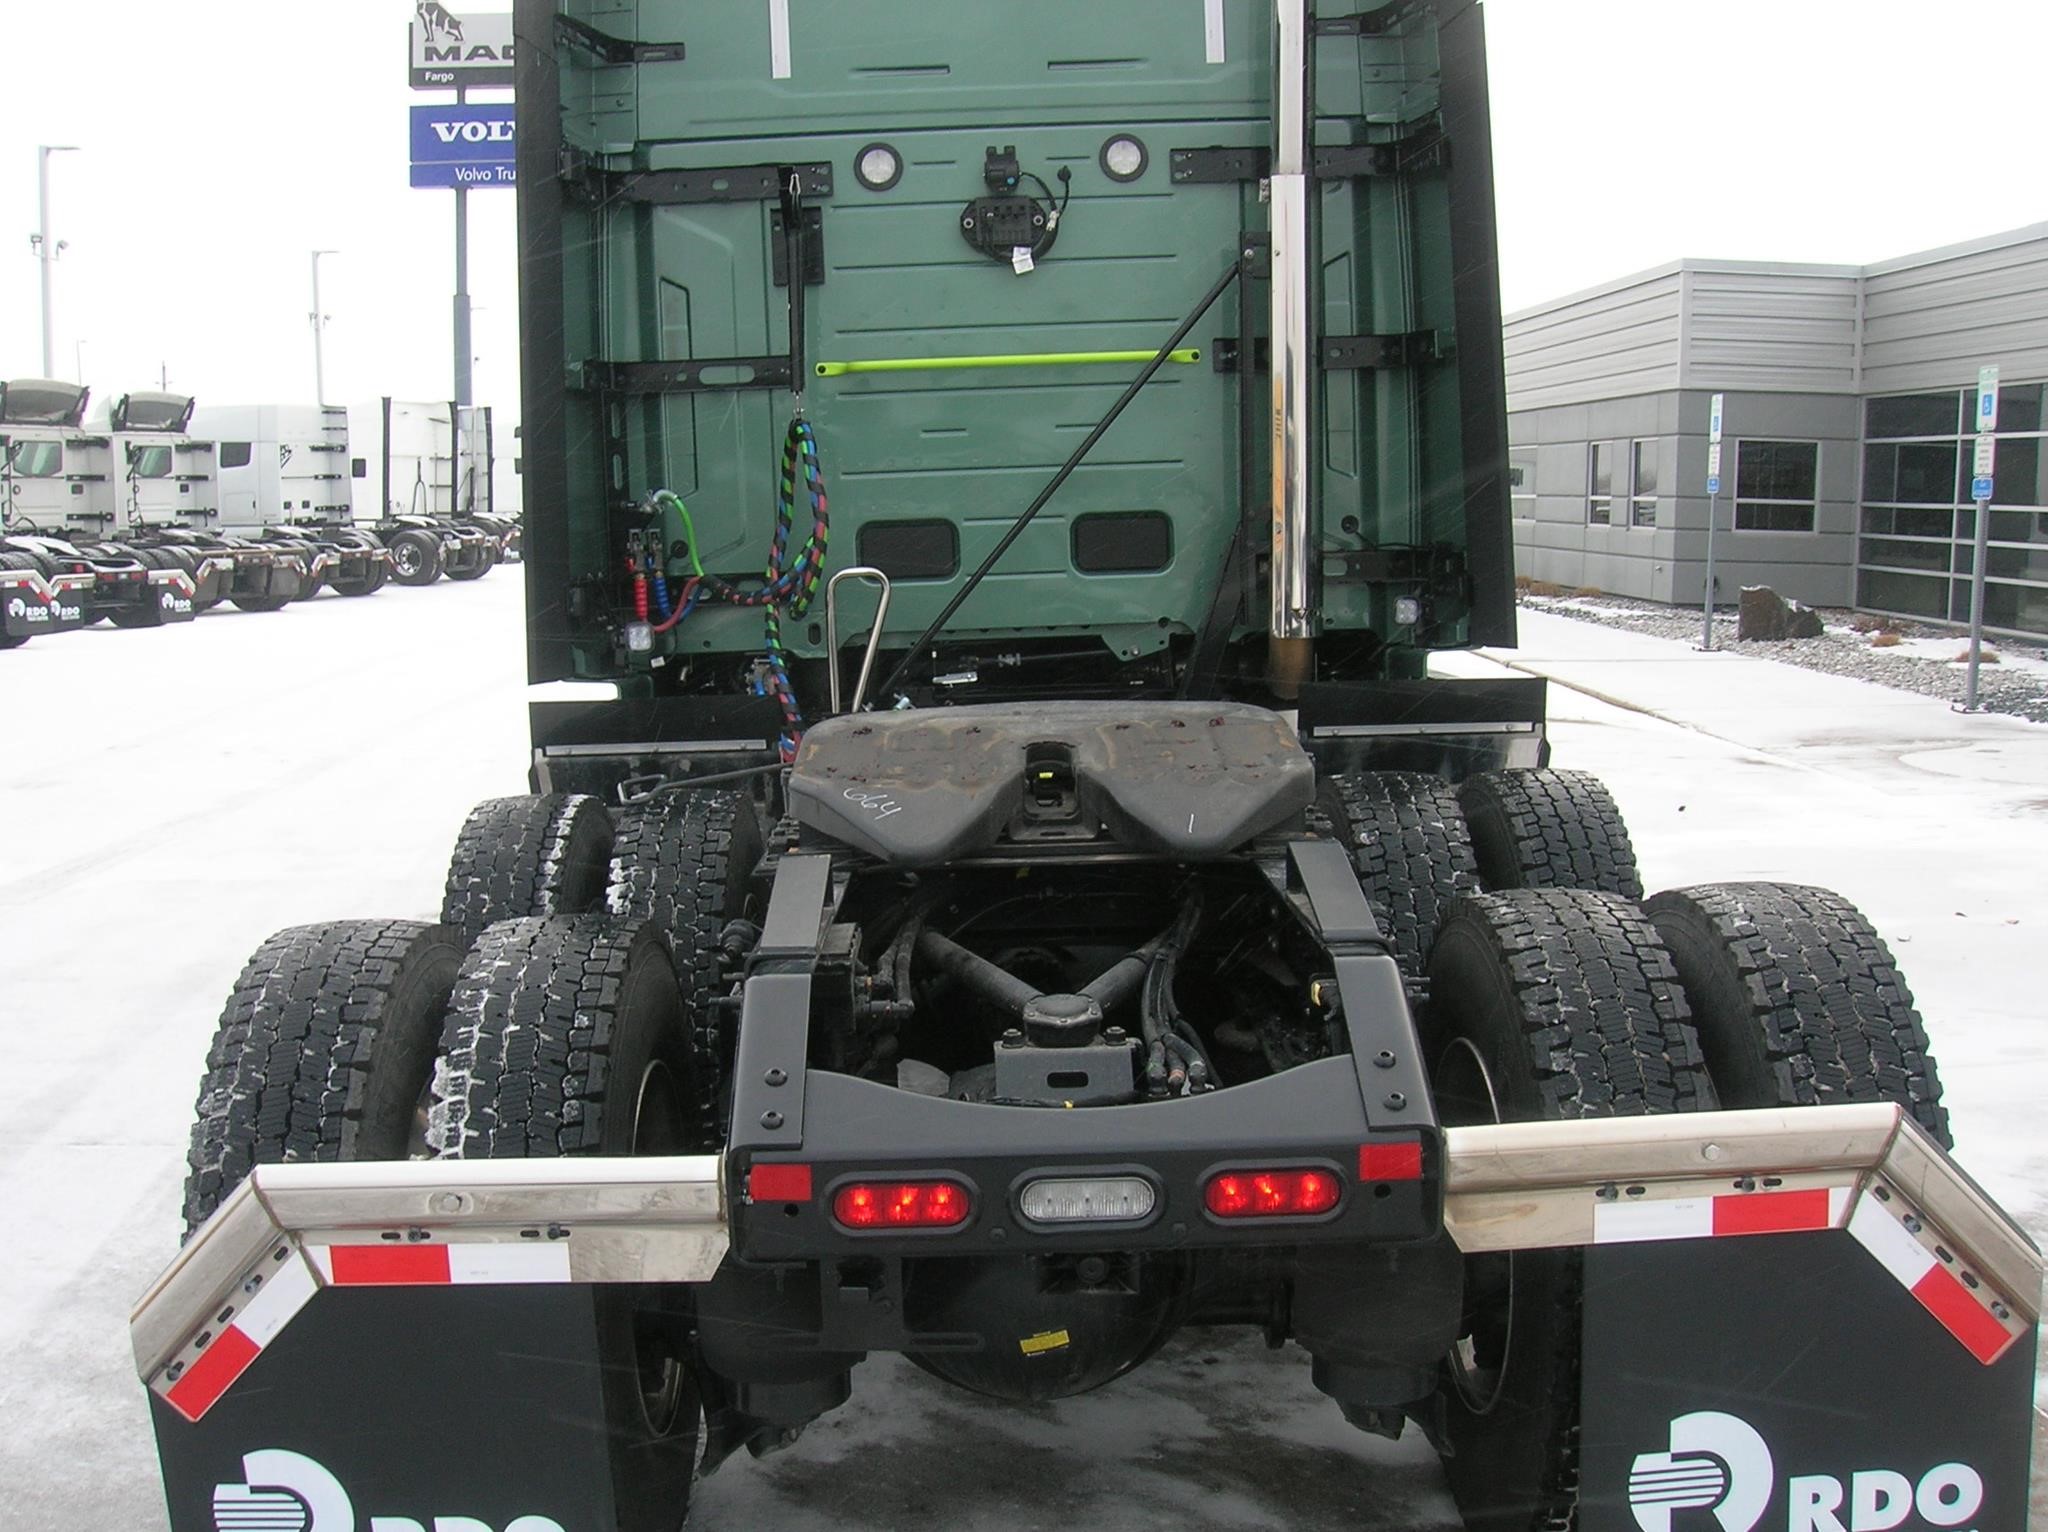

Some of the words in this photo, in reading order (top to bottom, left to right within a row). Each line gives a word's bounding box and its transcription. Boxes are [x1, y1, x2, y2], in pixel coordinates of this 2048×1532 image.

[425, 72, 454, 82] Fargo
[430, 121, 516, 143] VOL
[455, 168, 491, 181] Volvo
[26, 606, 48, 616] RDO
[1788, 1462, 1984, 1532] RDO
